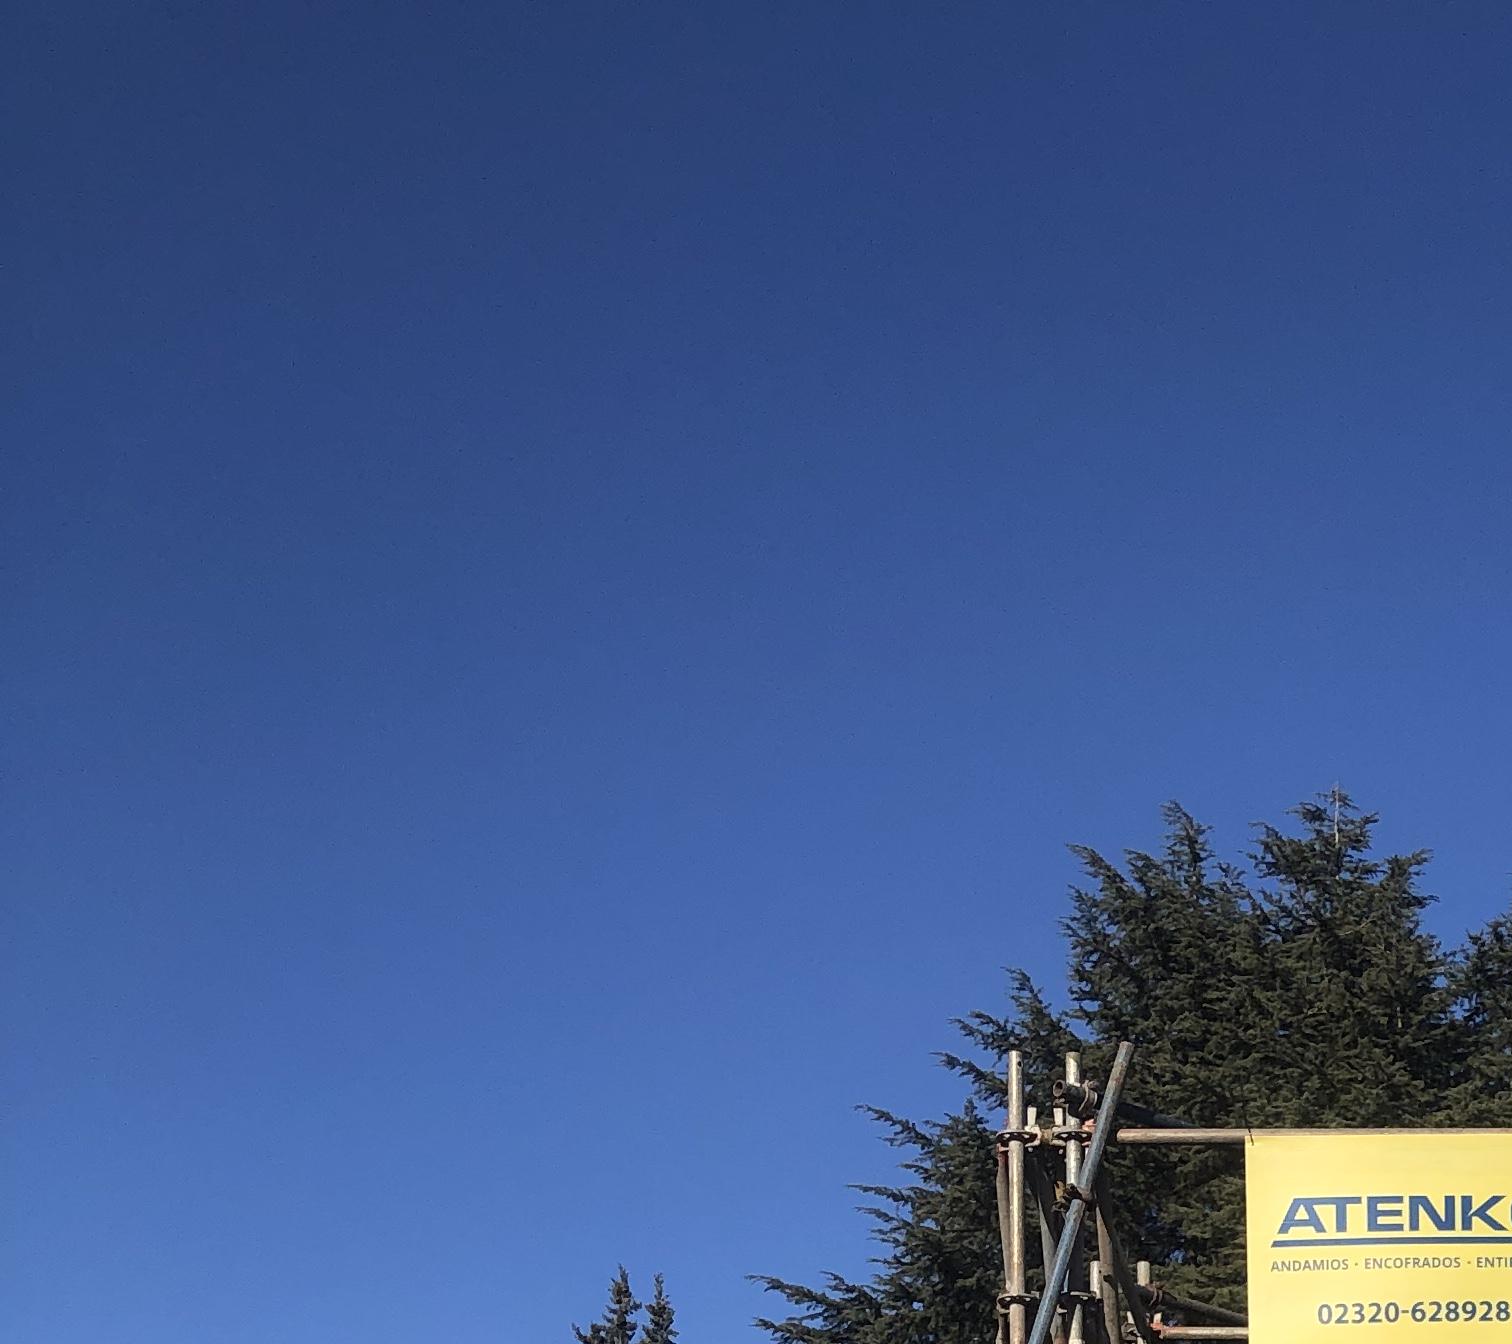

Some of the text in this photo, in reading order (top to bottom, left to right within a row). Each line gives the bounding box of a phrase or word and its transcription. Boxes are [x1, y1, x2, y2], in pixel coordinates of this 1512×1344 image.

[1270, 1258, 1350, 1273] ANDAMIOS
[1364, 1257, 1461, 1270] ENCOFRADOS
[1317, 1301, 1512, 1325] 02320-628928
